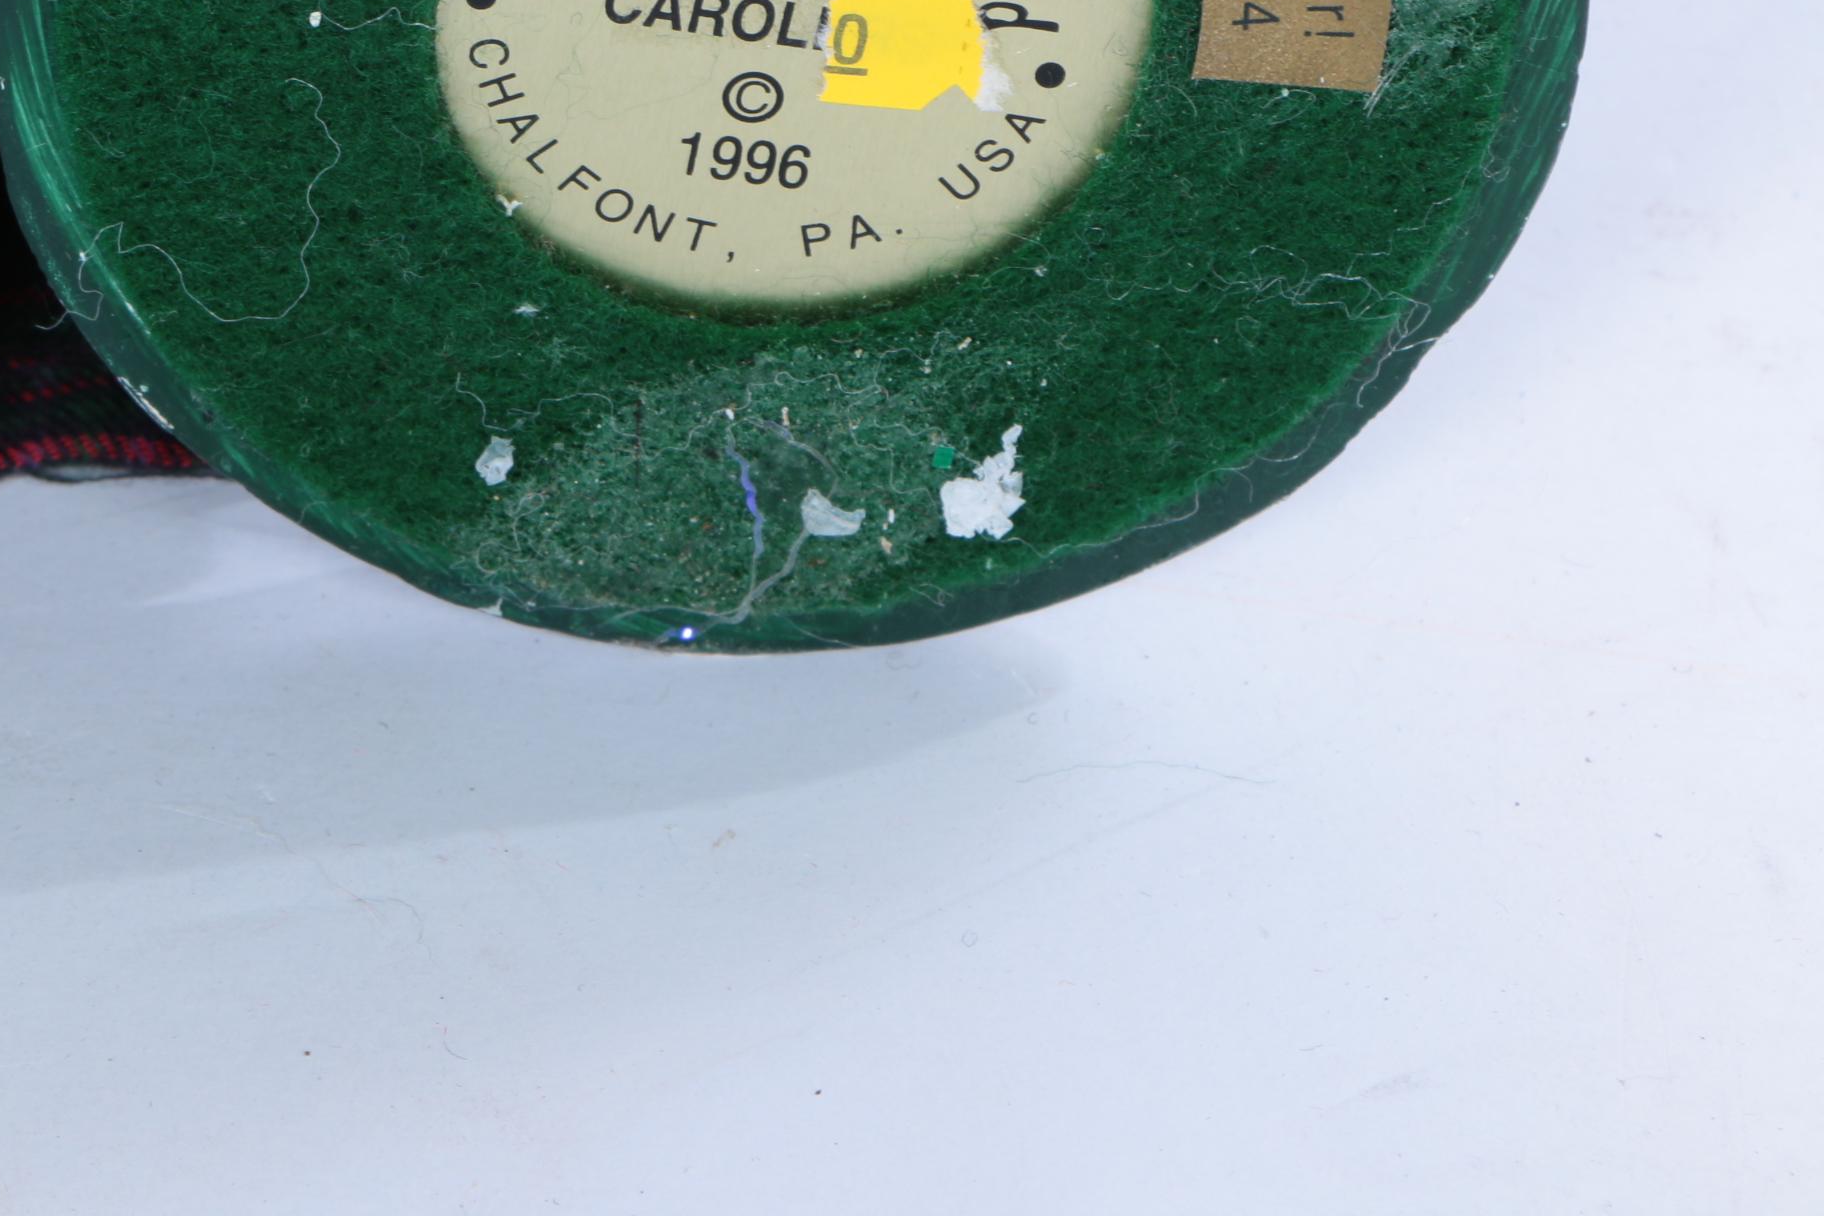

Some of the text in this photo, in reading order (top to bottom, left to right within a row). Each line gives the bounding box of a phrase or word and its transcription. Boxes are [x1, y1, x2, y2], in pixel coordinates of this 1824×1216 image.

[468, 38, 1047, 262] CHALFONT, PA. USA
[680, 131, 812, 189] 1996
